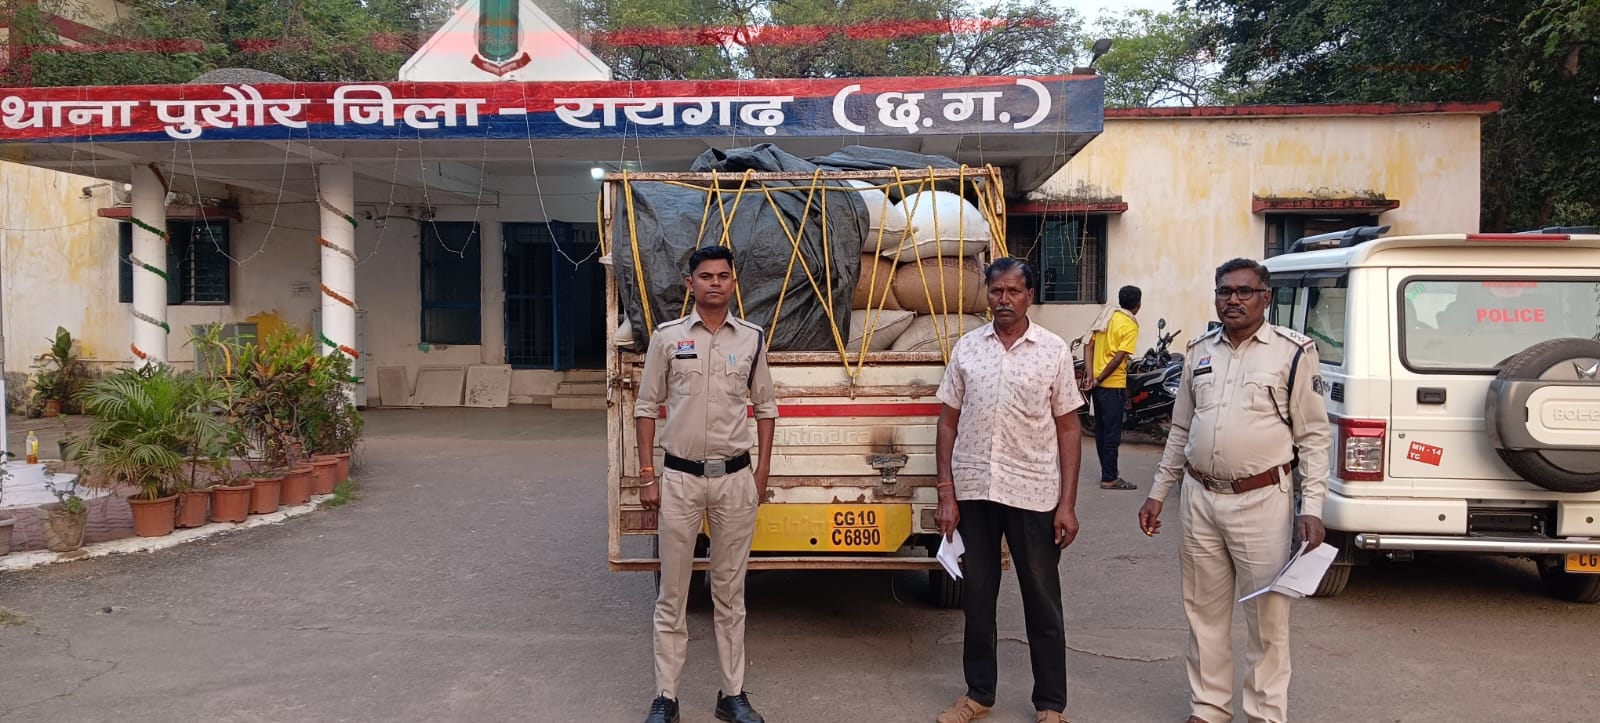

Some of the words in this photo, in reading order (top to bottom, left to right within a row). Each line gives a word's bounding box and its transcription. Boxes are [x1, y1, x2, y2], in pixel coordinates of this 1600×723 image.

[1, 97, 139, 130] थाना
[151, 84, 311, 140] पुसौर
[327, 85, 487, 129] जिला
[554, 93, 794, 136] रायगढ़
[1476, 308, 1545, 323] POLICE
[1411, 444, 1425, 452] MH
[1410, 452, 1421, 460] TC
